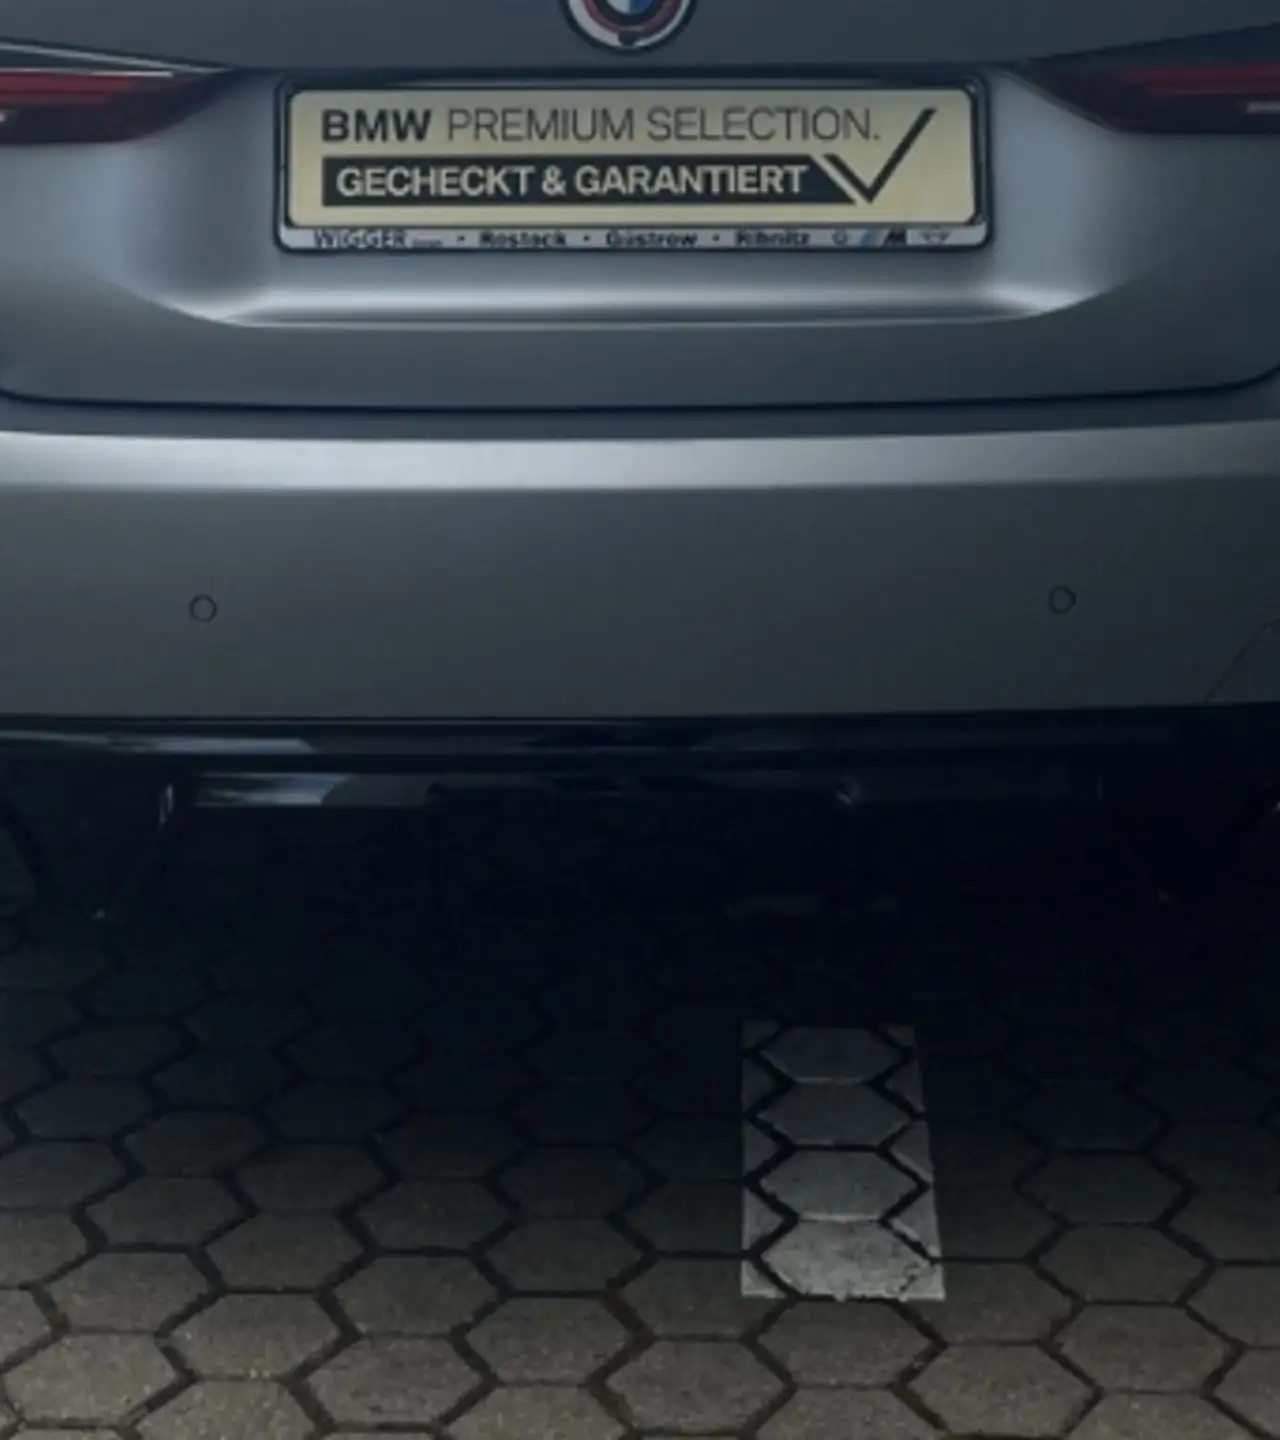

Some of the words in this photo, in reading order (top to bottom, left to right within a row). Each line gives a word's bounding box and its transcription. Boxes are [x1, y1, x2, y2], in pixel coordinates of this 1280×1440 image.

[322, 107, 432, 142] BMW
[448, 107, 634, 142] PREMIUM
[646, 106, 881, 142] SELECTION.
[336, 165, 534, 197] GECHECKT
[541, 165, 567, 197] &
[574, 165, 808, 197] GARANTIERT
[314, 228, 406, 249] WIGGER
[479, 229, 566, 249] Rostock
